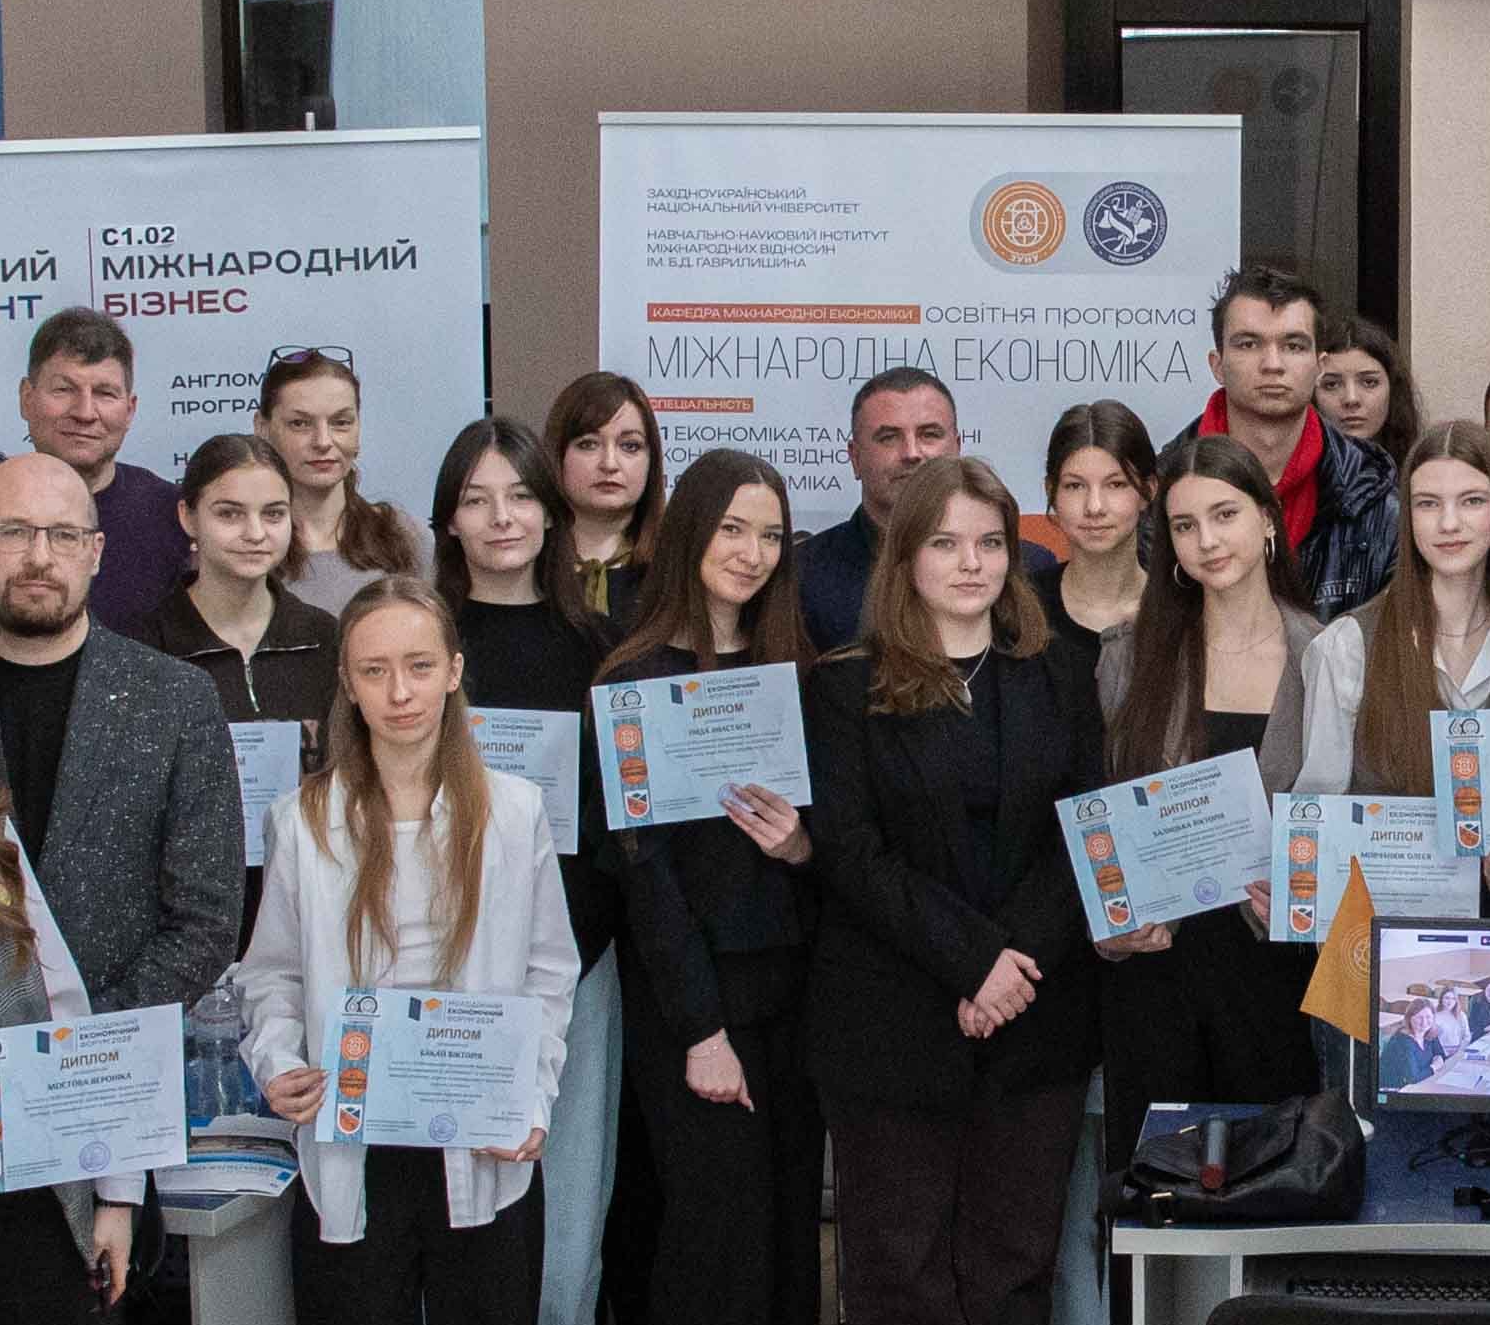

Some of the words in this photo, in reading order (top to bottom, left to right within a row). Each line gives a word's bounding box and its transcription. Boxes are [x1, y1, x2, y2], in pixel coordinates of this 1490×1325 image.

[647, 187, 806, 199] ЗАХІДНОУКРАЇНСЬКИЙ
[647, 201, 761, 214] НАЦІОНАЛЬНИЙ
[764, 202, 860, 214] УНІВЕРСИТЕТ
[820, 230, 889, 242] ІНСТИТУТ
[647, 243, 758, 255] МІЖНАРОДНИХ
[760, 243, 836, 256] ВІДНОСИН
[102, 238, 418, 281] МІЖНАРОДНИЙ
[696, 256, 807, 269] ГАВРИЛИШИНА
[103, 288, 249, 317] БІЗНЕС
[653, 306, 720, 320] КАФЕДРА
[723, 306, 827, 321] МІЖНАРОДНОЇ
[830, 308, 913, 321] ЕКОНОМІКИ
[925, 301, 1035, 325] освітня
[1045, 306, 1197, 328] програма
[647, 335, 939, 385] МІЖНАРОДНА
[954, 337, 1192, 384] ЕКОНОМІКА
[171, 371, 265, 390] АНГЛОМ
[171, 398, 261, 416] ПРОГРА
[674, 426, 803, 442] ЕКОНОМІКА
[806, 427, 830, 442] ТА
[783, 449, 850, 466] ВІДНО
[692, 702, 745, 719] ДИПЛОМ
[1159, 795, 1210, 818] ДИПЛОМ
[1370, 830, 1423, 842] ДИПЛОМ
[426, 1027, 482, 1040] ДИПЛОМ
[60, 1051, 120, 1071] ДИПЛОМ
